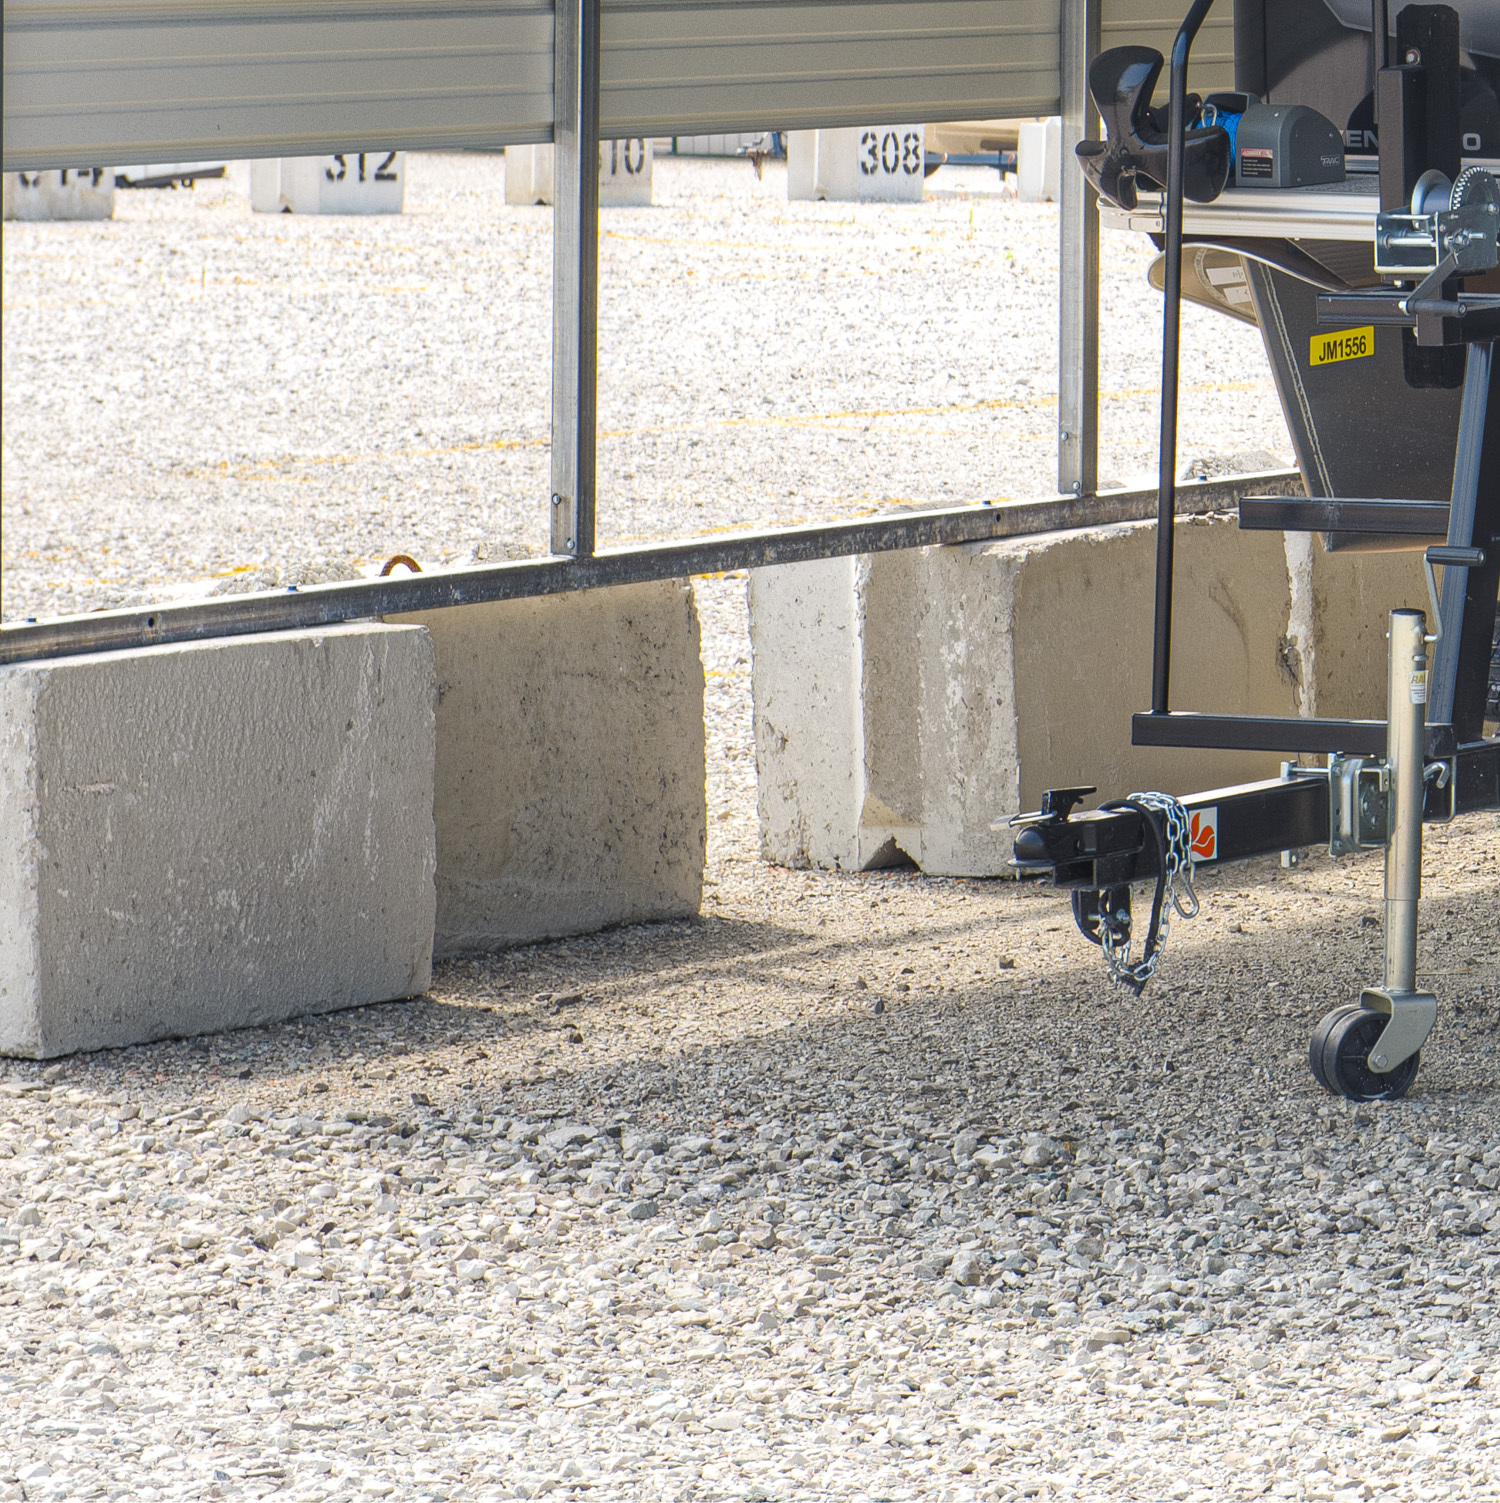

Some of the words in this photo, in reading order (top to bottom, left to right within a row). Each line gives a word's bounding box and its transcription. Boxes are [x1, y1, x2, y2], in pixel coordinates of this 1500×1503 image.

[325, 151, 398, 182] 312
[604, 138, 646, 176] 10
[860, 131, 921, 176] 308
[1318, 335, 1367, 362] JM1556
